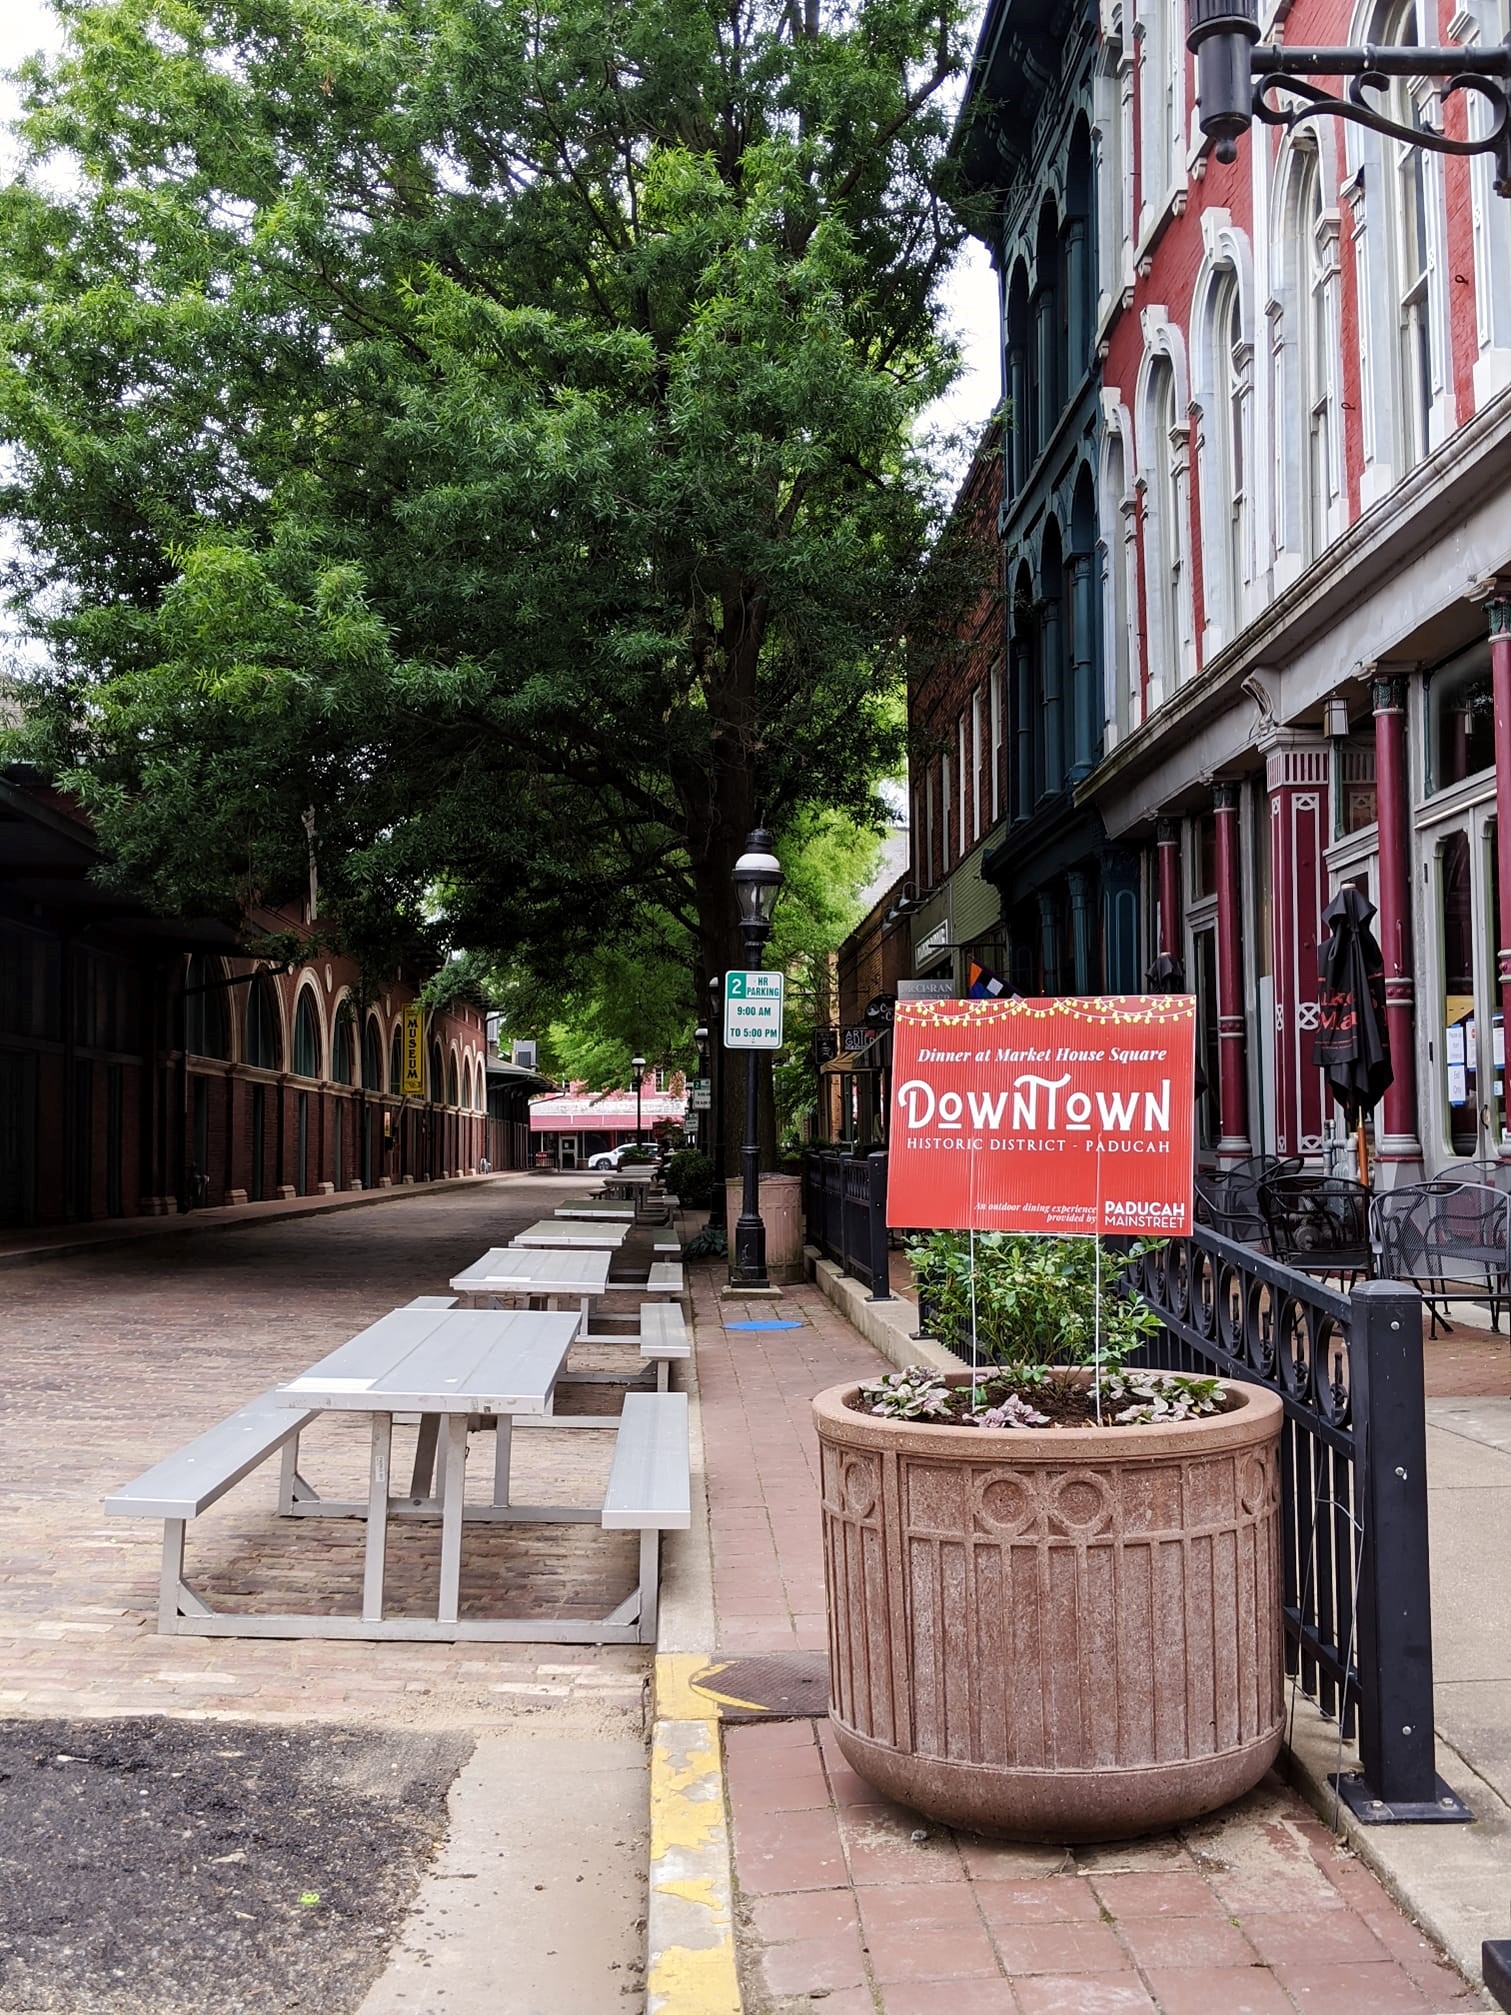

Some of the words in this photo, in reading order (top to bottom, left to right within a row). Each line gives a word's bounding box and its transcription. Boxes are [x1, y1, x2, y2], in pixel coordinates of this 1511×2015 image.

[731, 978, 742, 994] 2
[757, 976, 769, 986] HR
[747, 987, 779, 997] PARKING
[737, 1006, 756, 1016] 9:00
[758, 1007, 771, 1016] AM
[730, 1028, 741, 1037] TO
[743, 1028, 762, 1037] 5:00
[765, 1029, 777, 1037] PM
[407, 1019, 418, 1079] MUSEUM
[917, 1048, 972, 1063] Dinner
[975, 1047, 991, 1062] at
[995, 1047, 1051, 1062] Market
[1055, 1047, 1104, 1062] House
[1108, 1047, 1167, 1065] Square
[907, 1137, 983, 1150] HISTORIC
[990, 1138, 1066, 1151] DISTRICT
[1086, 1140, 1170, 1153] PADUCAH
[988, 1202, 1020, 1211] outdoor
[1022, 1202, 1050, 1214] dining
[1051, 1204, 1097, 1215] experience
[1105, 1200, 1185, 1217] PADUCAH
[1046, 1213, 1084, 1224] provided
[1086, 1214, 1096, 1224] by
[1105, 1215, 1185, 1229] MAINSTREET
